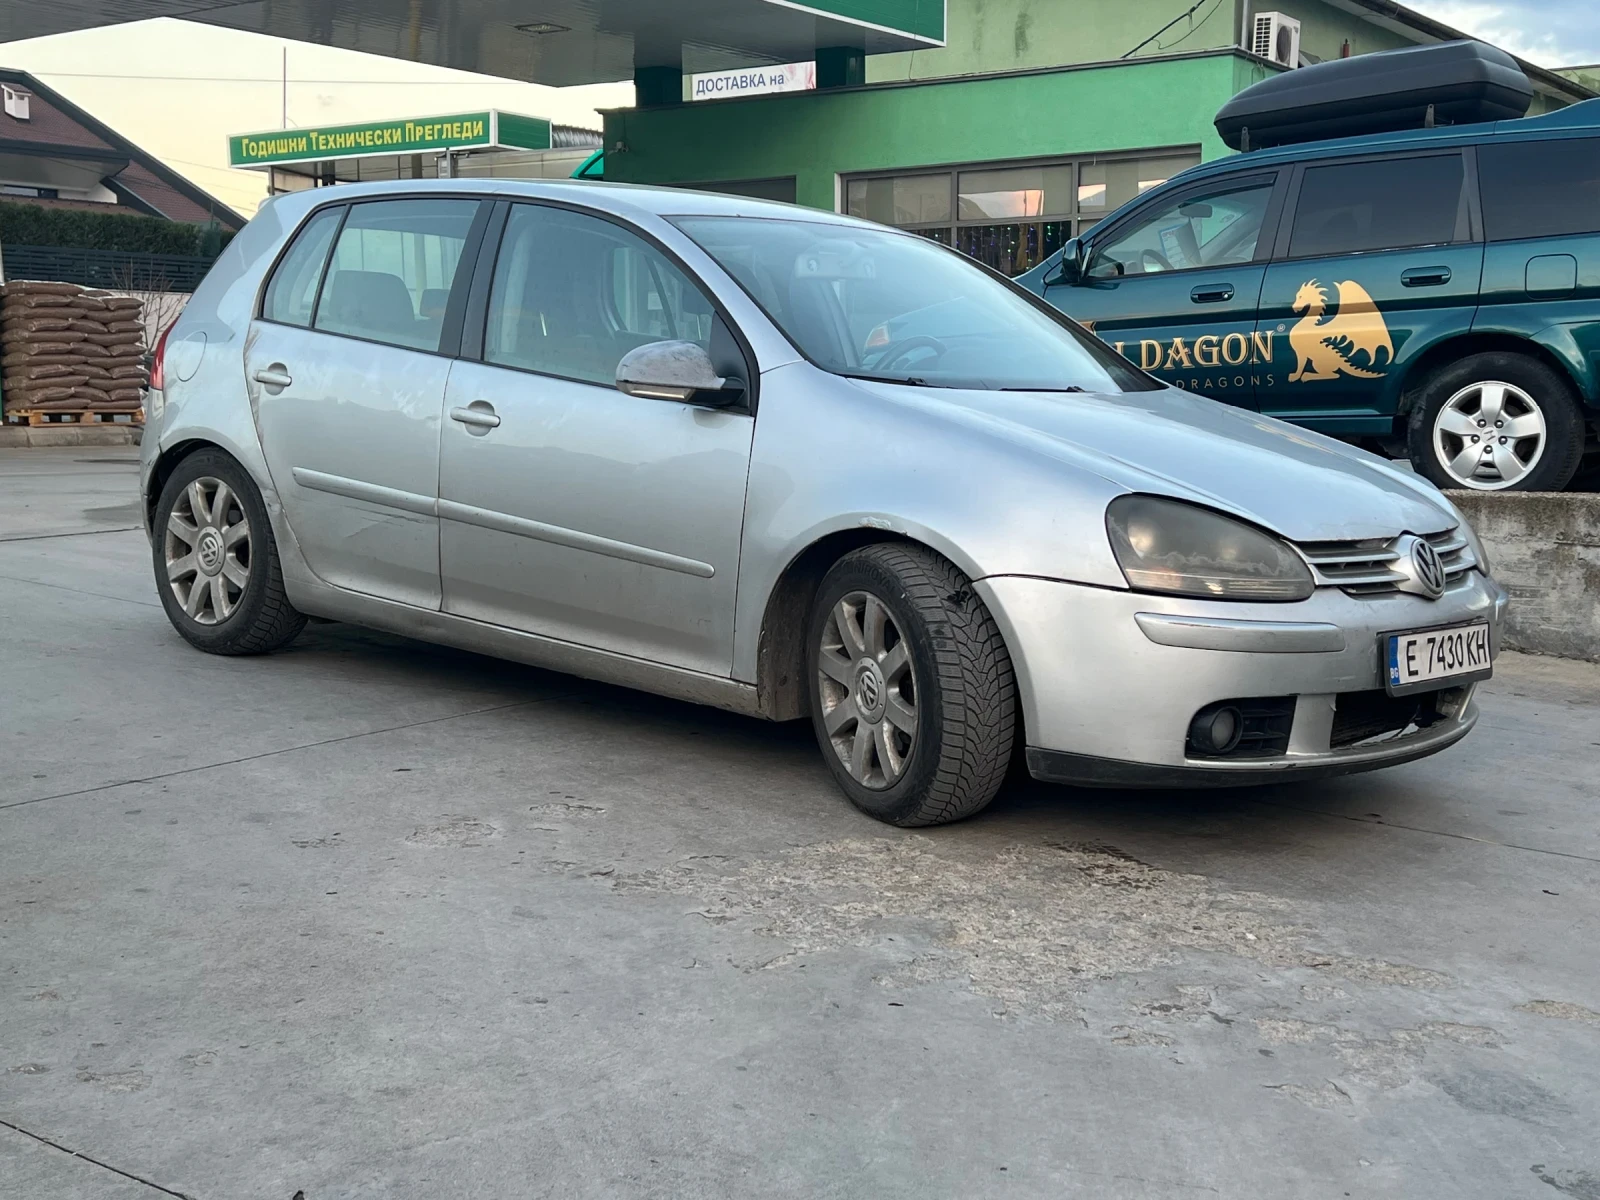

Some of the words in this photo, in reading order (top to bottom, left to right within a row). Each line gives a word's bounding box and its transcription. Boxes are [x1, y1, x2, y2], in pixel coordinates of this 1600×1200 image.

[696, 73, 766, 96] ДОСТАВКА
[769, 74, 785, 86] на
[1176, 373, 1275, 390] DRAGONS
[1406, 639, 1419, 677] E
